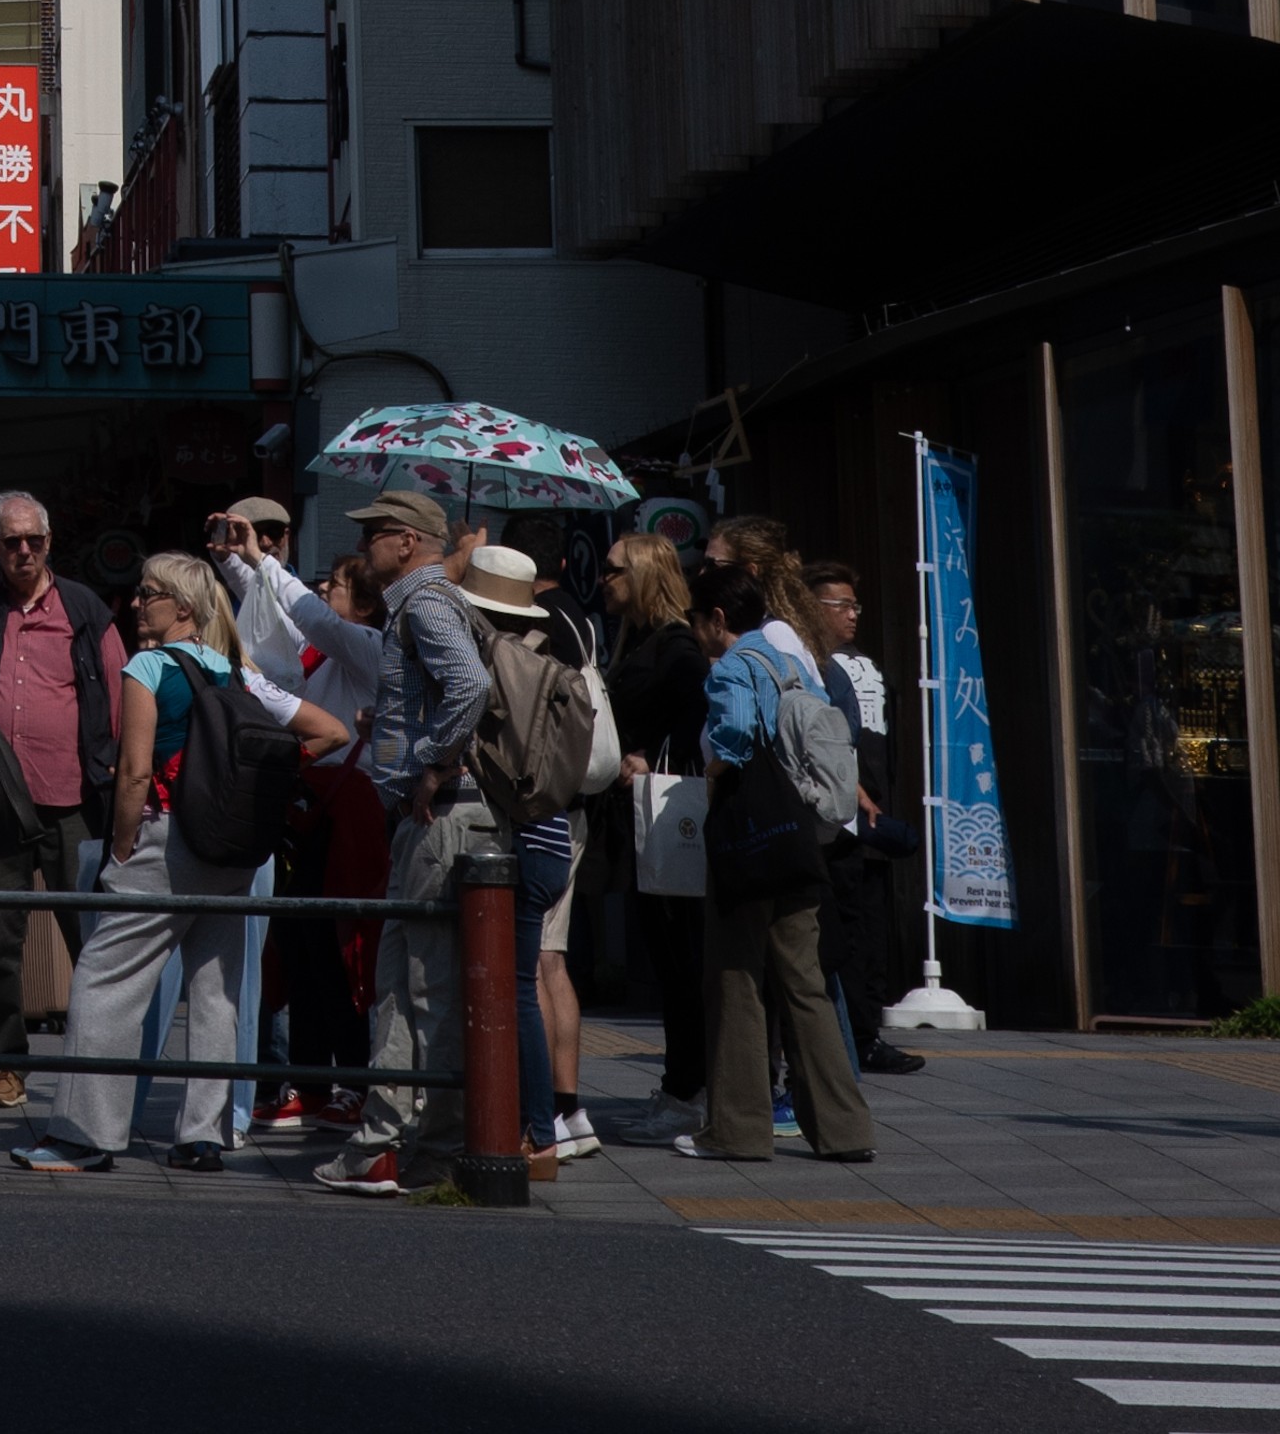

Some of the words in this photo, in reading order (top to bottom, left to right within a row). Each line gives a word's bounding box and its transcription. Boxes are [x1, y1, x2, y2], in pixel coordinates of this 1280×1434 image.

[967, 886, 984, 896] Rest
[986, 887, 1001, 896] area
[949, 897, 983, 906] prevent
